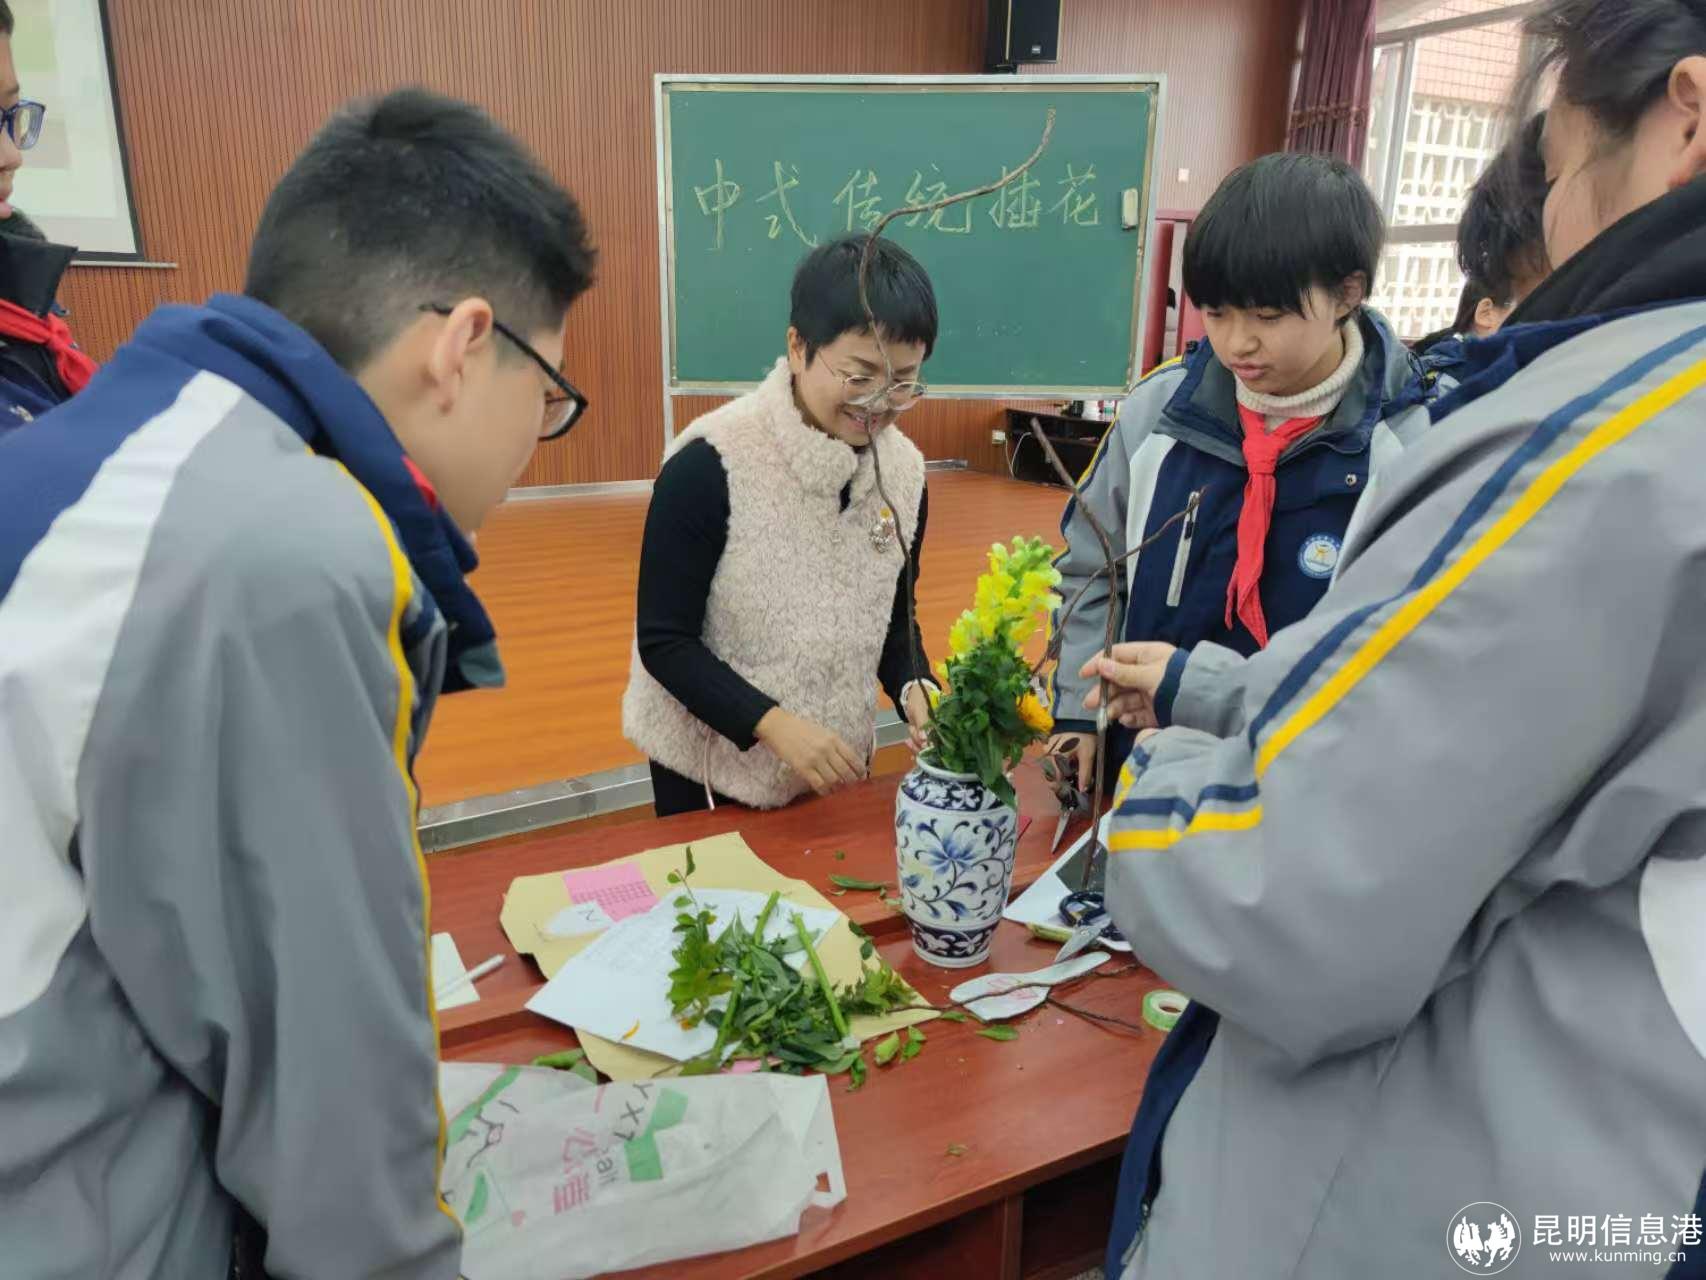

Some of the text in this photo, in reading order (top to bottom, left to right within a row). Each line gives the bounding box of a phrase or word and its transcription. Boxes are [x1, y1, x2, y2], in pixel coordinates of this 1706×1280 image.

[694, 158, 1100, 249] 中式传统插花
